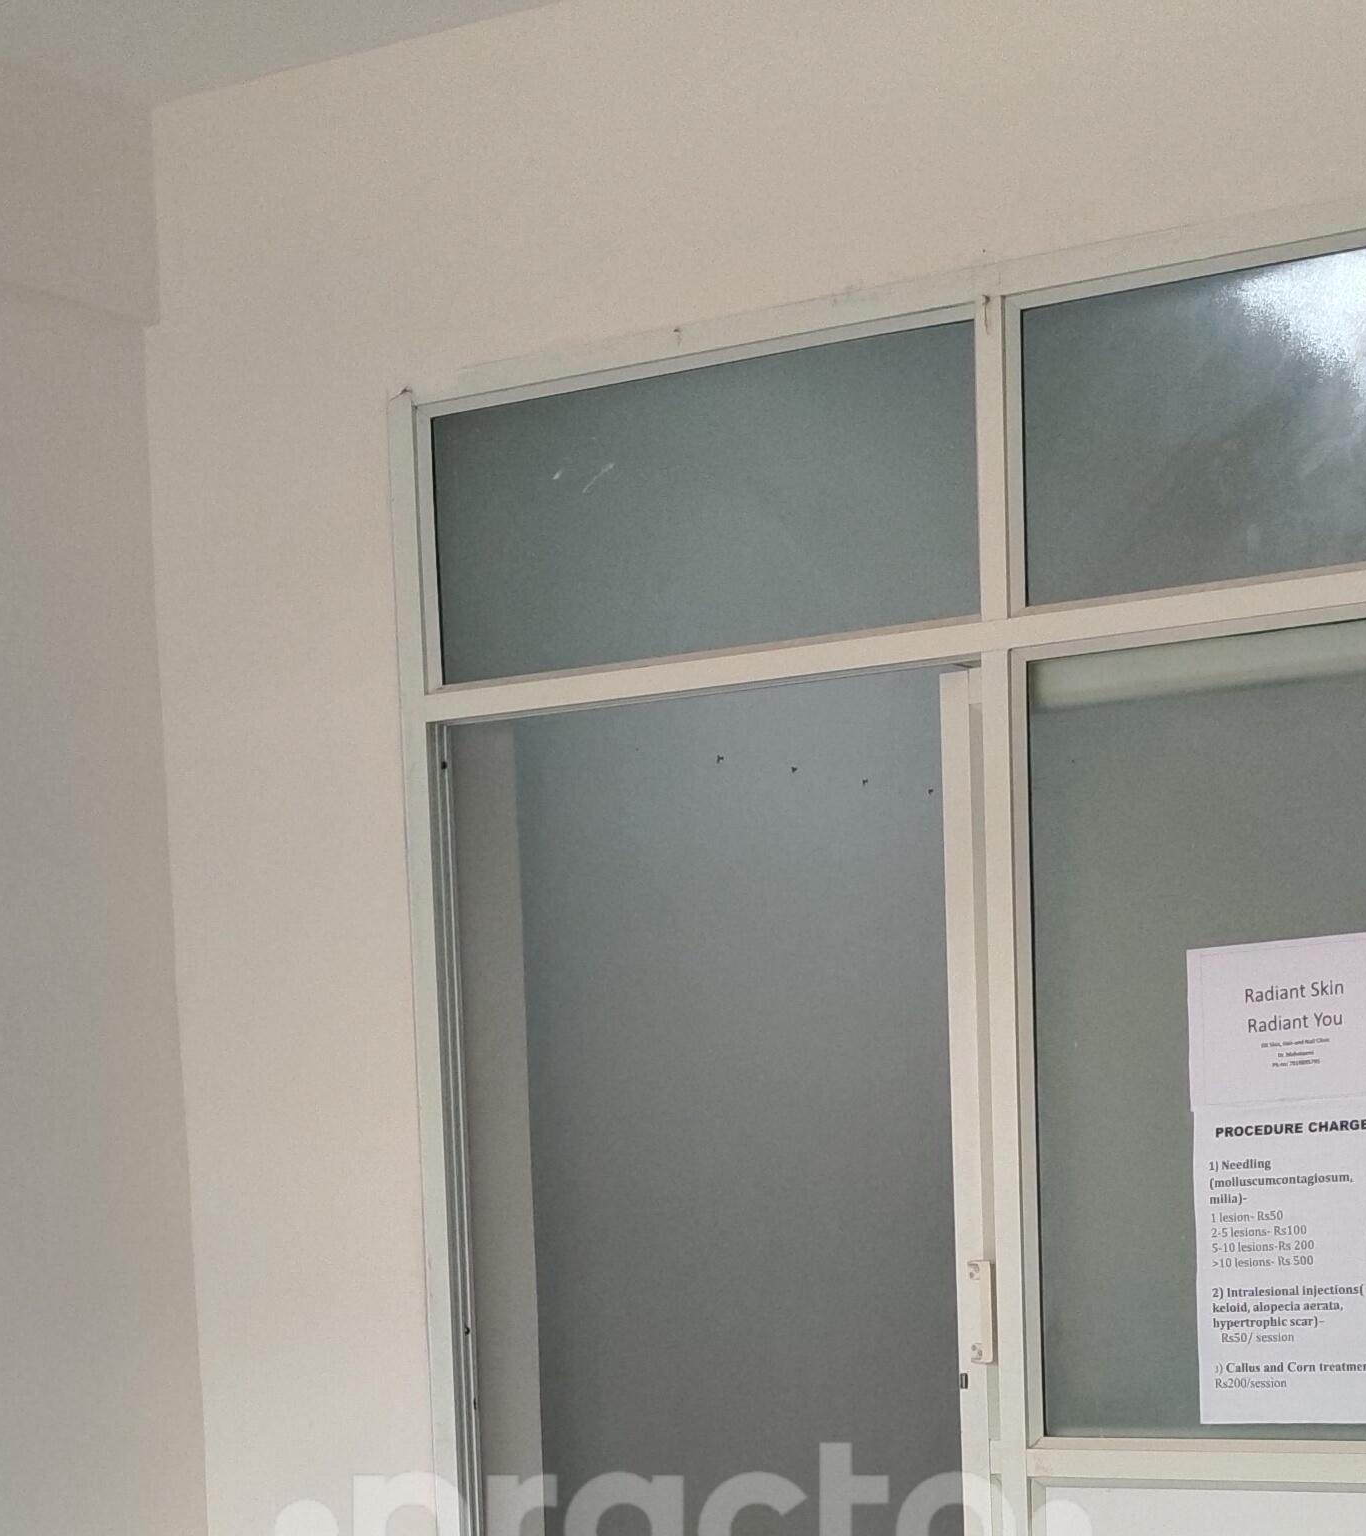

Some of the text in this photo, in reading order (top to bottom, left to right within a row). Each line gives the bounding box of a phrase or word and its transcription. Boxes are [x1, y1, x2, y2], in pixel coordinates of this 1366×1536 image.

[1245, 980, 1344, 1003] Radiant Skin
[1248, 1012, 1342, 1033] Radiant You
[1216, 1123, 1303, 1138] PROCEDURE
[1209, 1159, 1271, 1172] 1) Needling
[1211, 1213, 1216, 1223] 1
[1257, 1210, 1283, 1221] Rs50
[1211, 1227, 1228, 1238] 2-5
[1274, 1225, 1307, 1236] Rs100
[1212, 1242, 1235, 1253] 5-10
[1294, 1240, 1314, 1250] 200
[1278, 1256, 1291, 1266] Rs
[1293, 1255, 1313, 1266] 500
[1212, 1287, 1224, 1300] 2)
[1227, 1285, 1299, 1297] Intralesional
[1213, 1302, 1250, 1313] keloid,
[1253, 1301, 1300, 1314] alopecia
[1213, 1317, 1287, 1330] hypertrophic
[1256, 1332, 1294, 1342] session
[1226, 1363, 1260, 1373] Callus
[1264, 1362, 1284, 1372] and
[1287, 1362, 1315, 1372] Corn
